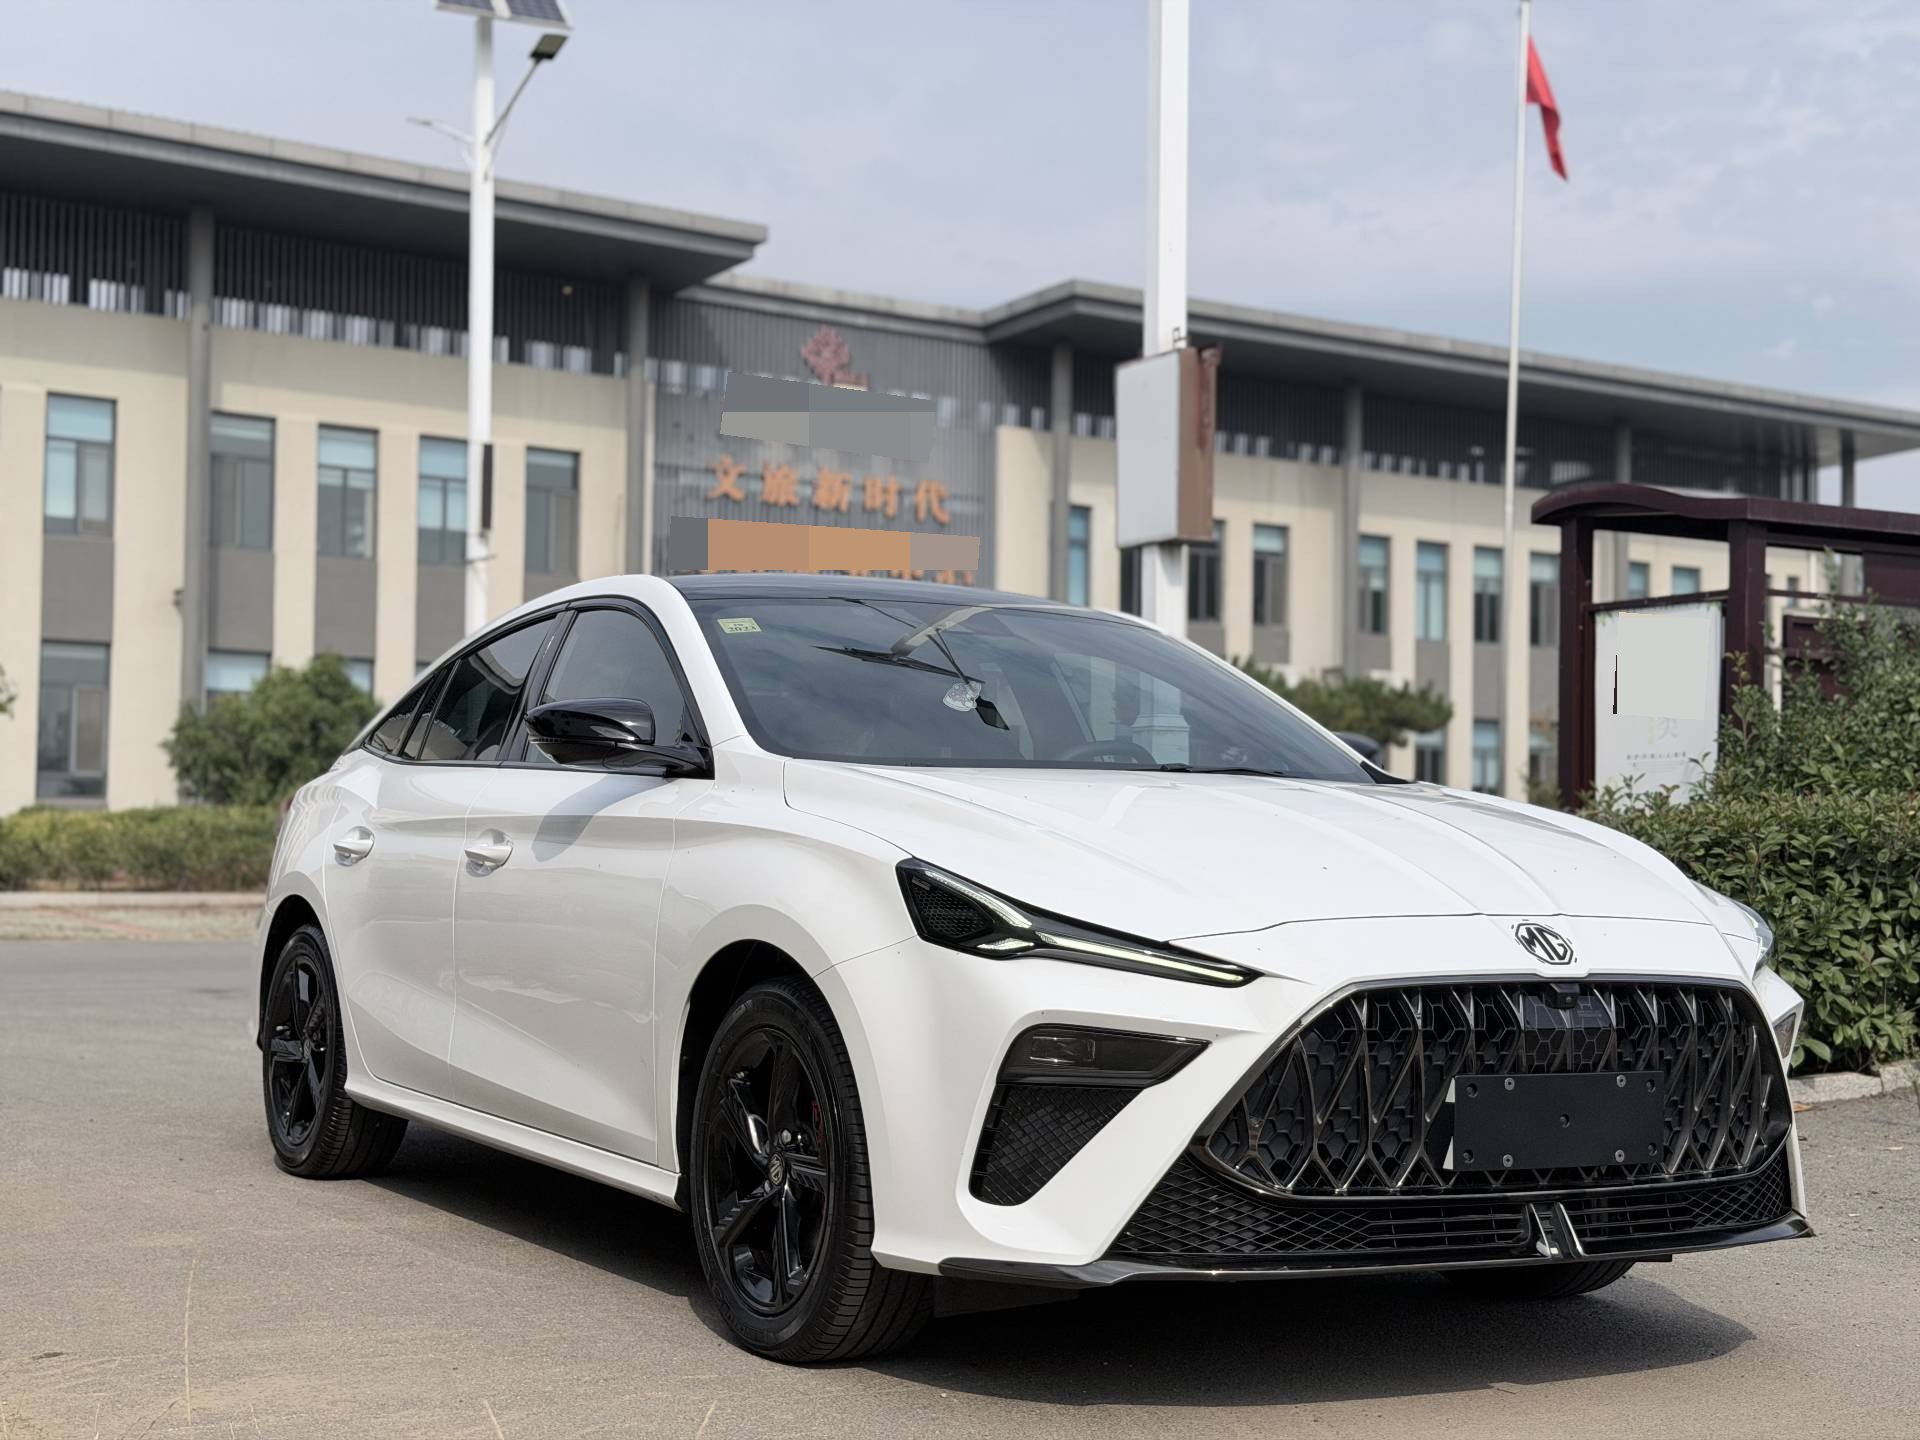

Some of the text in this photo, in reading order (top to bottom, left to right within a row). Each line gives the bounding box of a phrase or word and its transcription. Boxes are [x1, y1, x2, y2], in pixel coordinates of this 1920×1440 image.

[708, 455, 952, 525] 文旅新时代
[1520, 926, 1569, 961] MG
